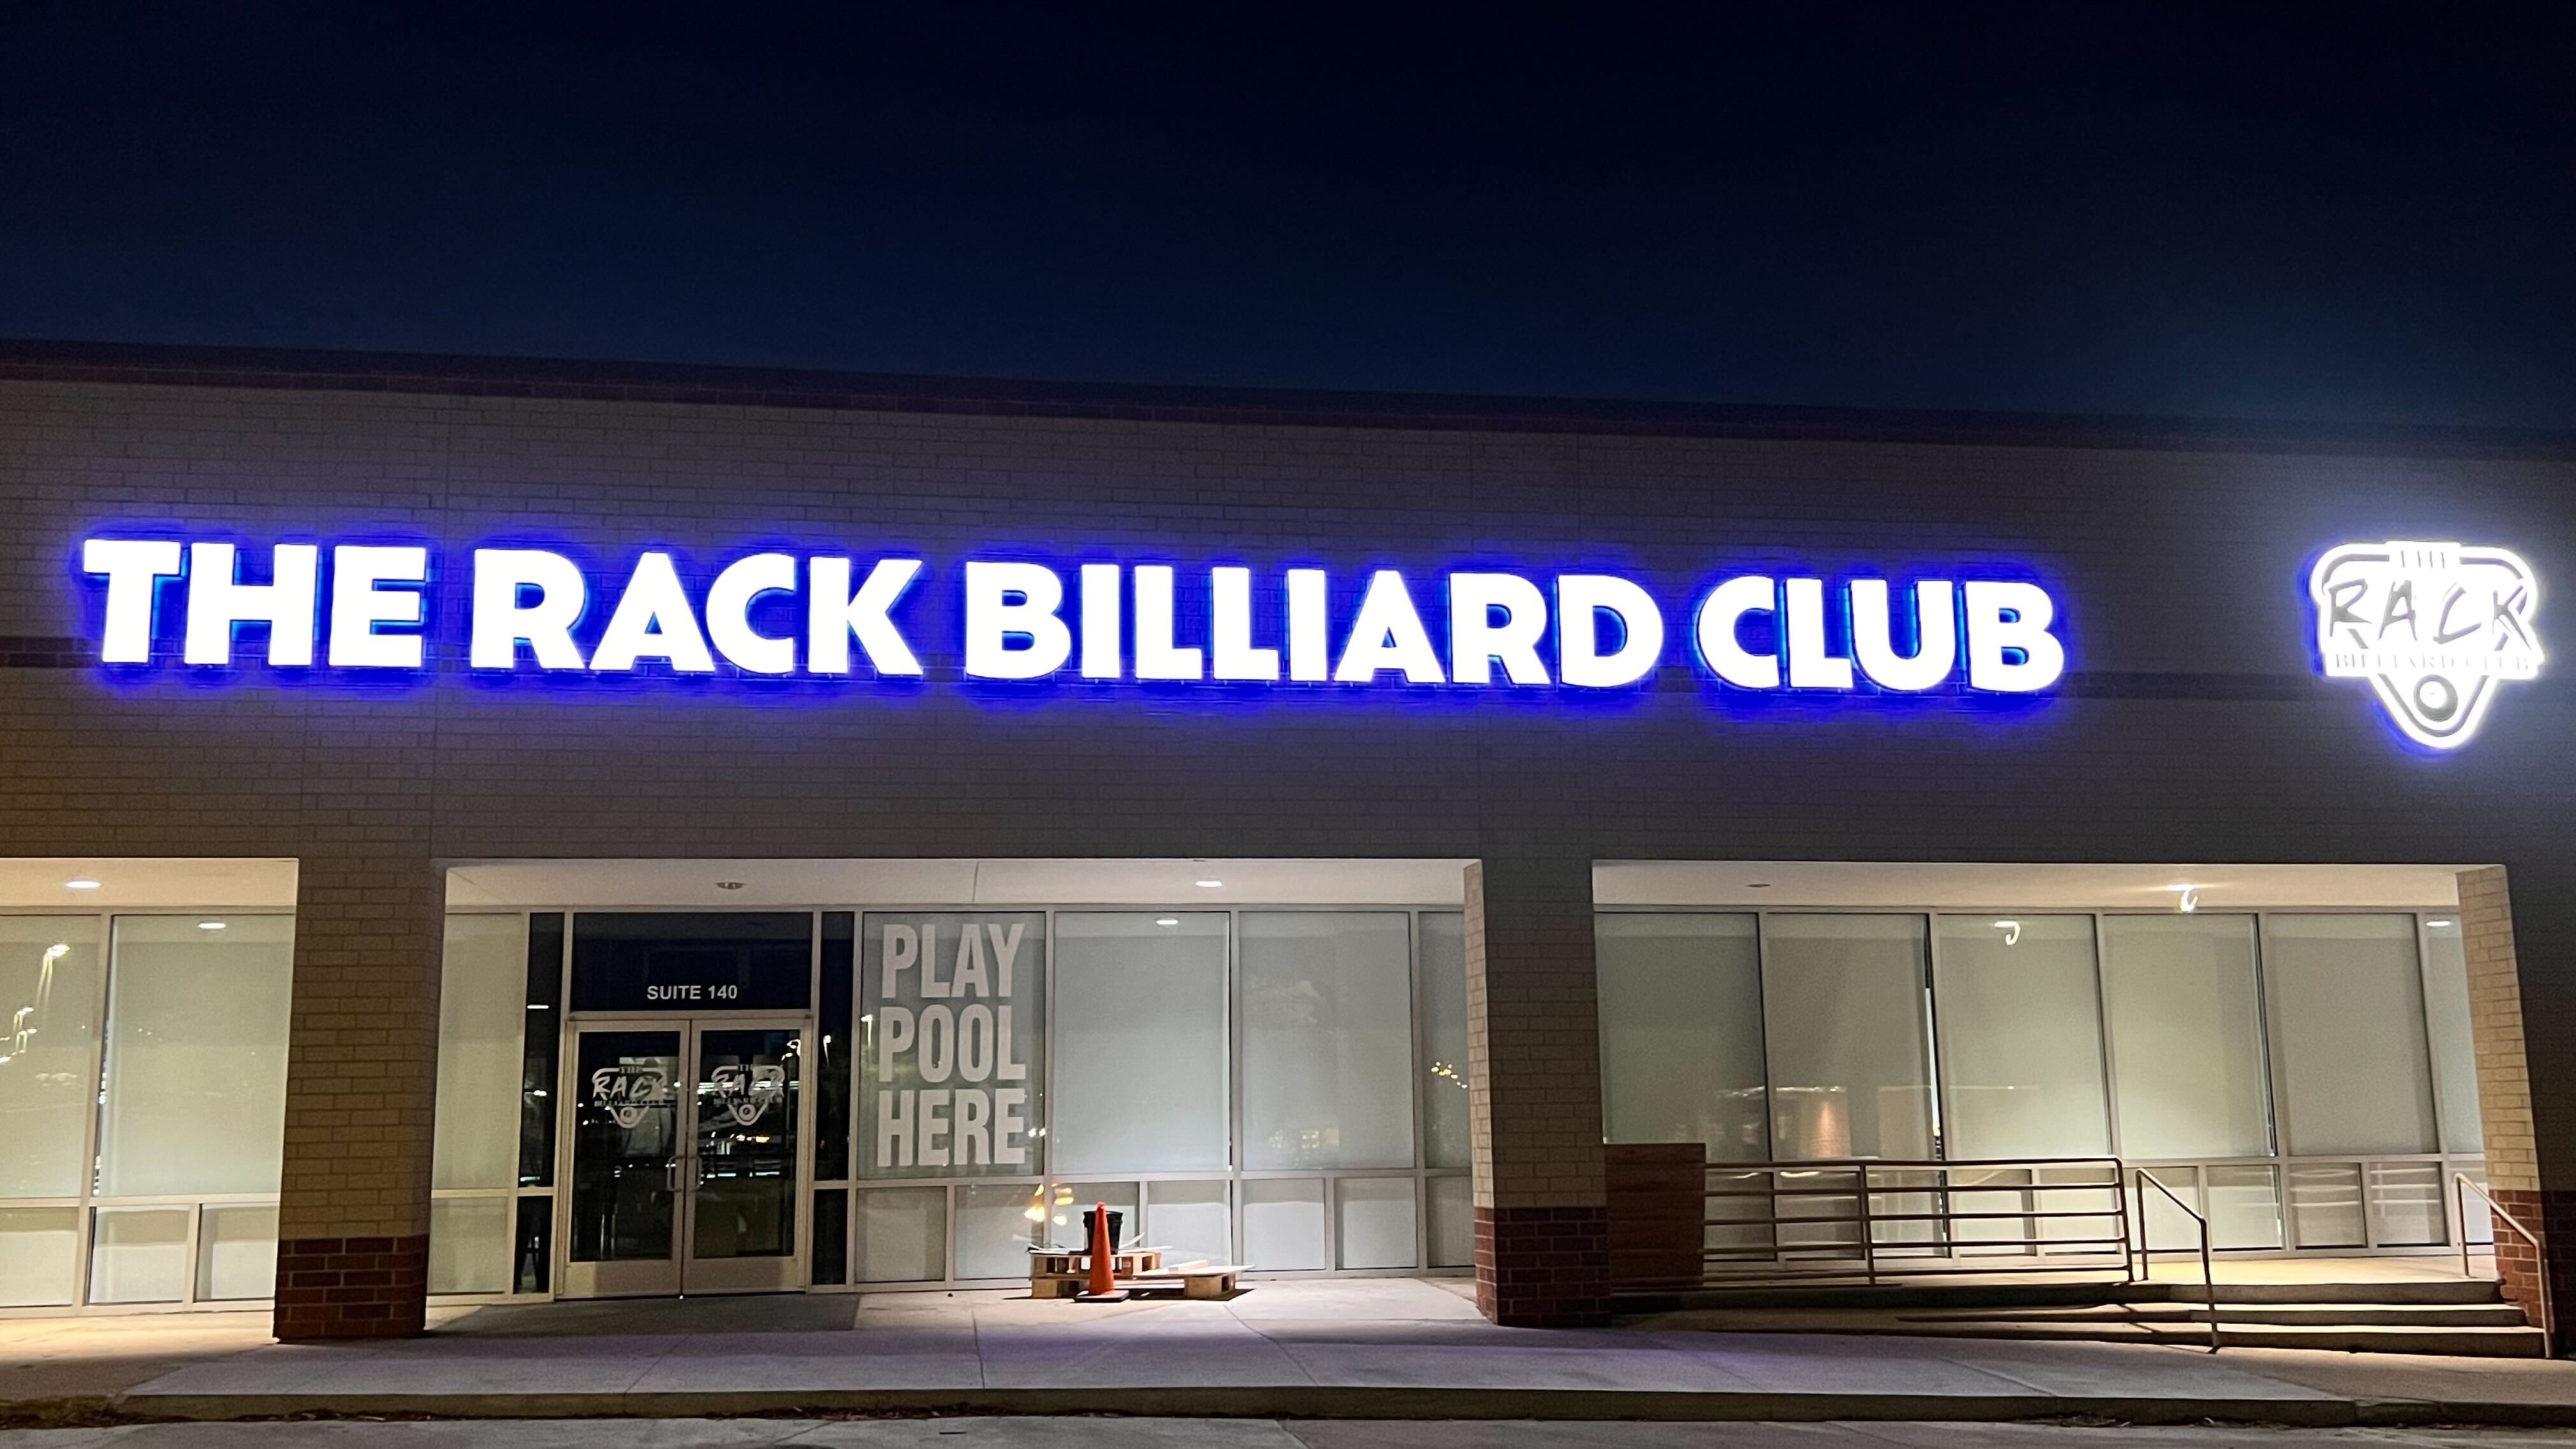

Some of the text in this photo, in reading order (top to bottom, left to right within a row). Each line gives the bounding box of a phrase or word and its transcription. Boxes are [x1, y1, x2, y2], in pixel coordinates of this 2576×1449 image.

[82, 539, 2064, 693] THE RACK BILLIARD CLUB
[2328, 578, 2532, 651] RACK
[647, 985, 738, 1000] SUITE 140
[882, 923, 1026, 999] PLAY
[878, 1004, 1027, 1083] POOL
[877, 1088, 1026, 1167] HERE
